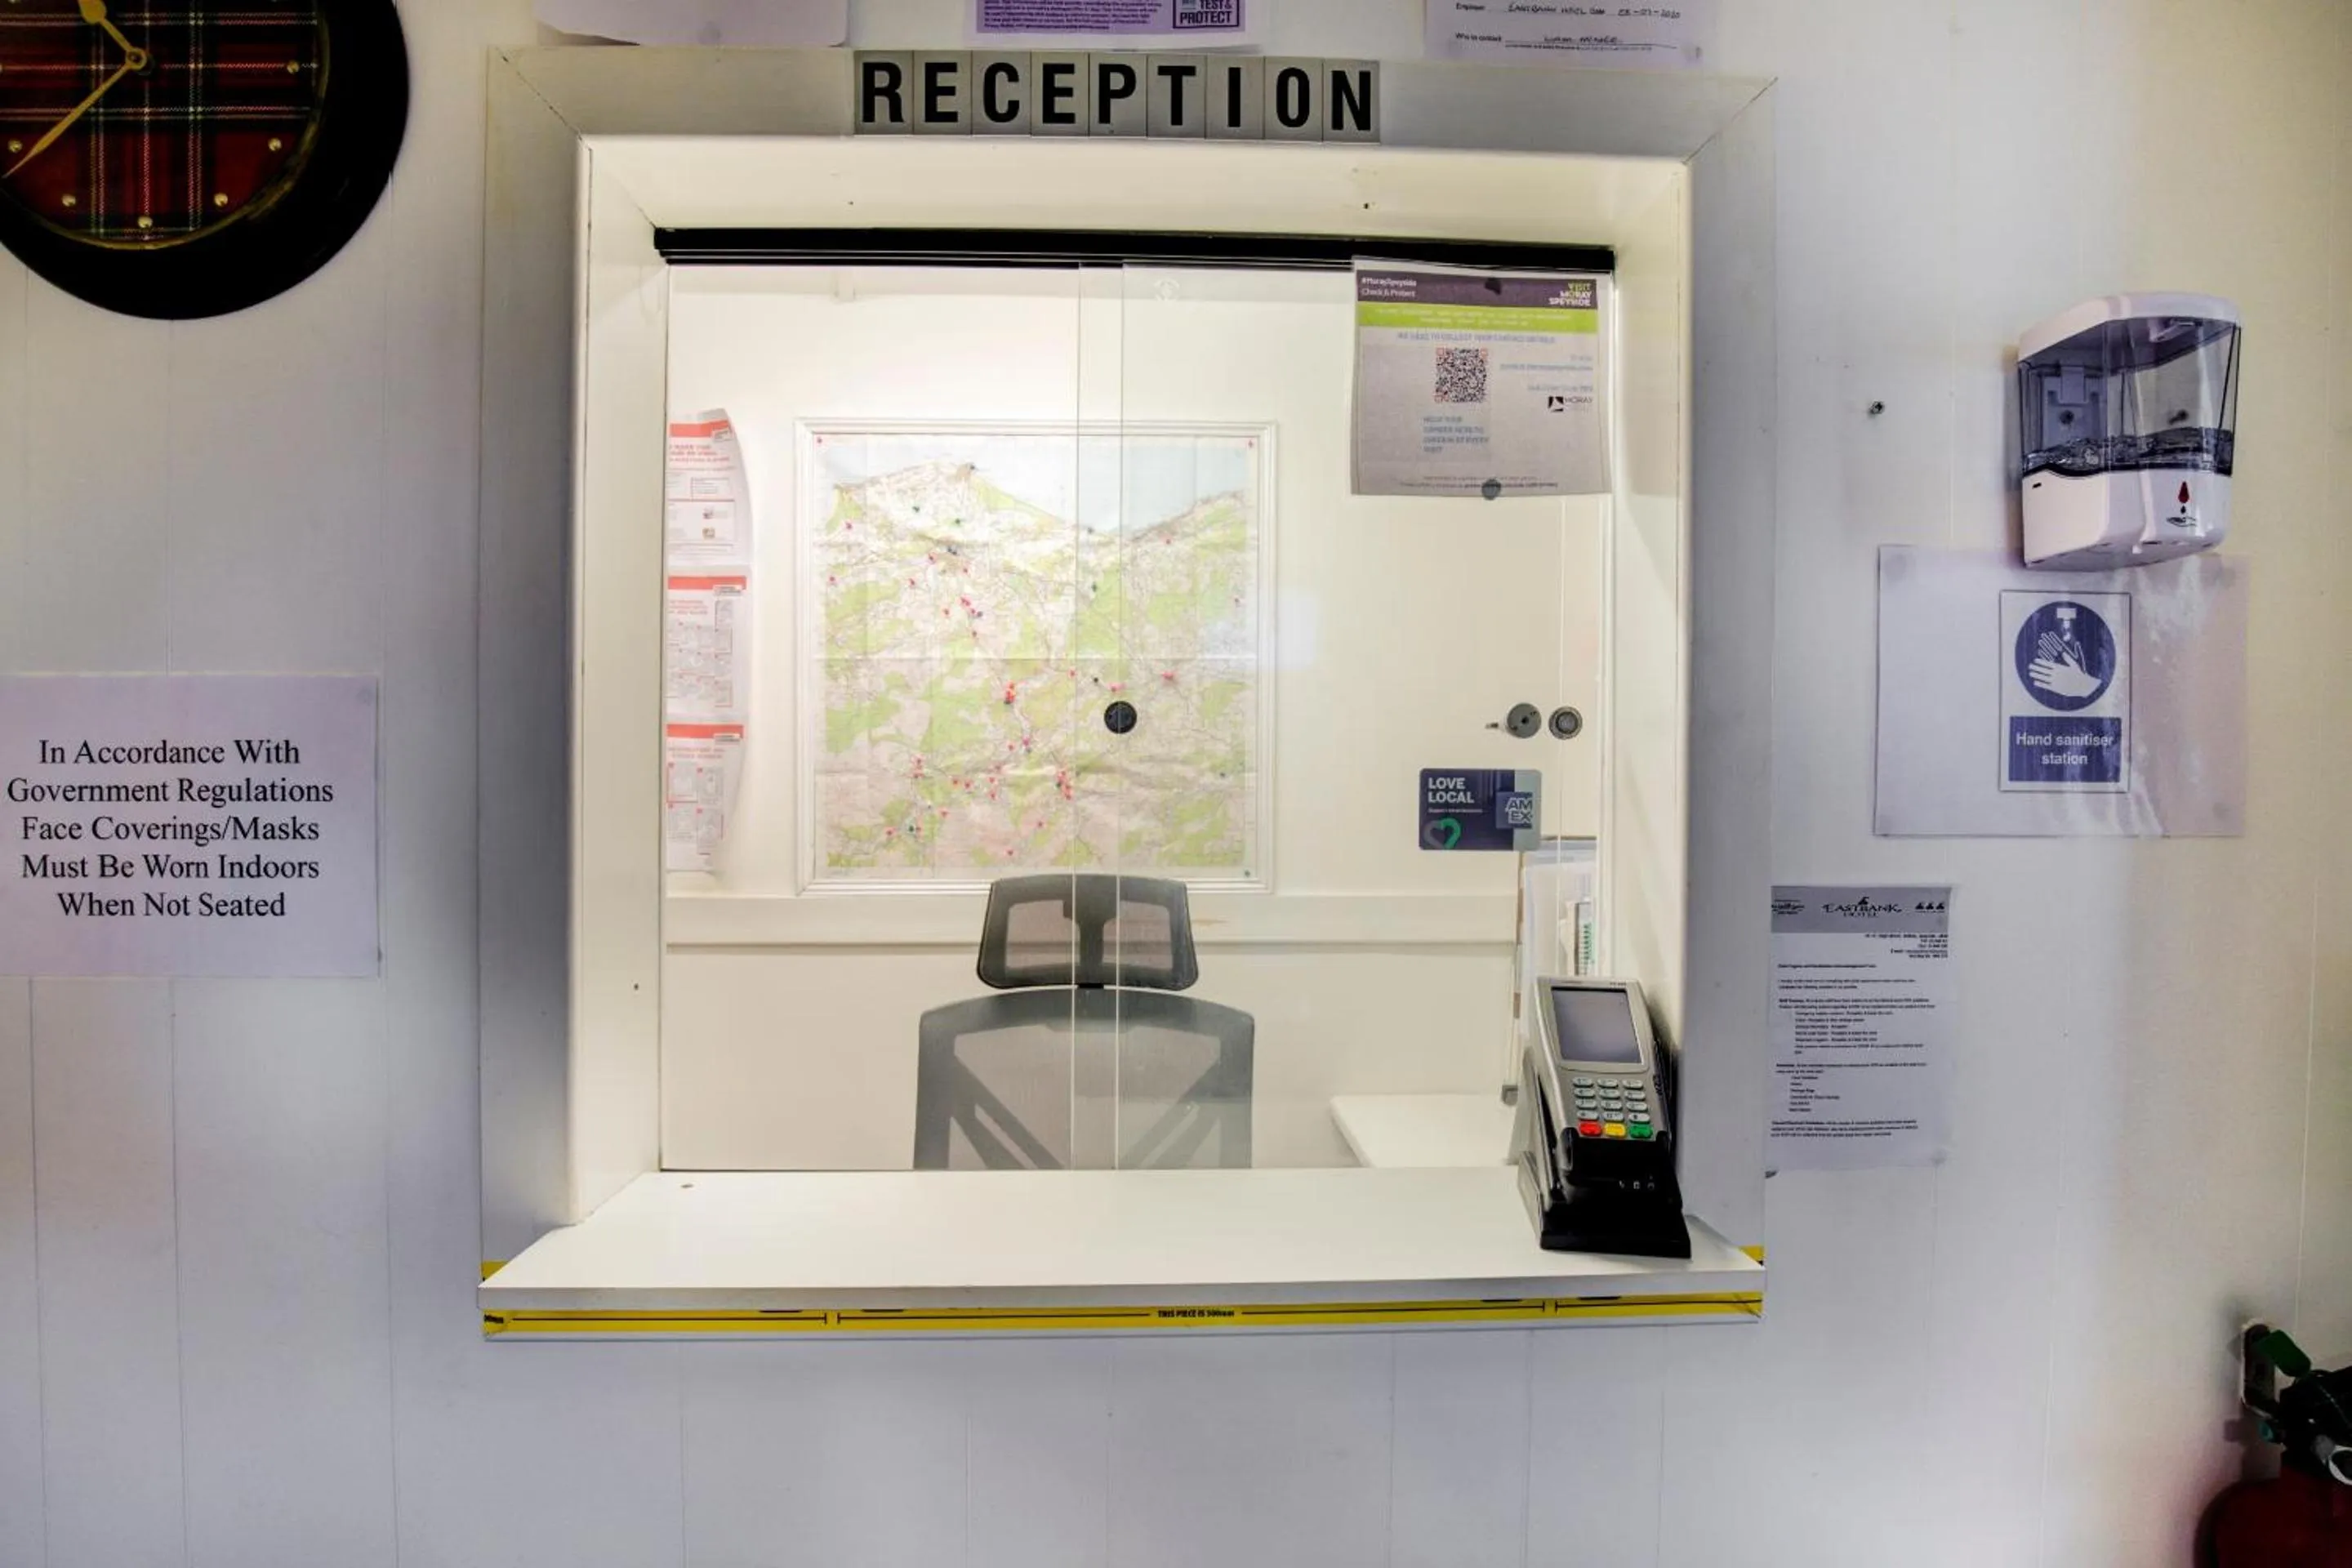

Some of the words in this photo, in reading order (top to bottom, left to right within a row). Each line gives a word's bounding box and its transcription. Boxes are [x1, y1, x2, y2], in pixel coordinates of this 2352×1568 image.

[1200, 0, 1223, 10] TEST
[1180, 11, 1232, 24] PROTECT
[862, 61, 1372, 131] RECEPTION
[2016, 732, 2053, 746] Hand
[2056, 733, 2114, 746] sanitiser
[39, 739, 65, 764] In
[74, 739, 225, 764] Accordance
[234, 739, 301, 764] With
[2041, 751, 2089, 765] station
[7, 777, 170, 803] Government
[177, 777, 334, 808] Regulations
[1428, 777, 1467, 790] LOVE
[1428, 791, 1475, 804] LOCAL
[21, 816, 82, 840] Face
[91, 815, 319, 847] Coverings/Masks
[21, 854, 88, 879] Must
[98, 854, 134, 879] Be
[144, 854, 209, 879] Worn
[218, 854, 319, 879] Indoors
[57, 893, 135, 916] When
[144, 893, 190, 916] Not
[198, 893, 286, 916] Seated
